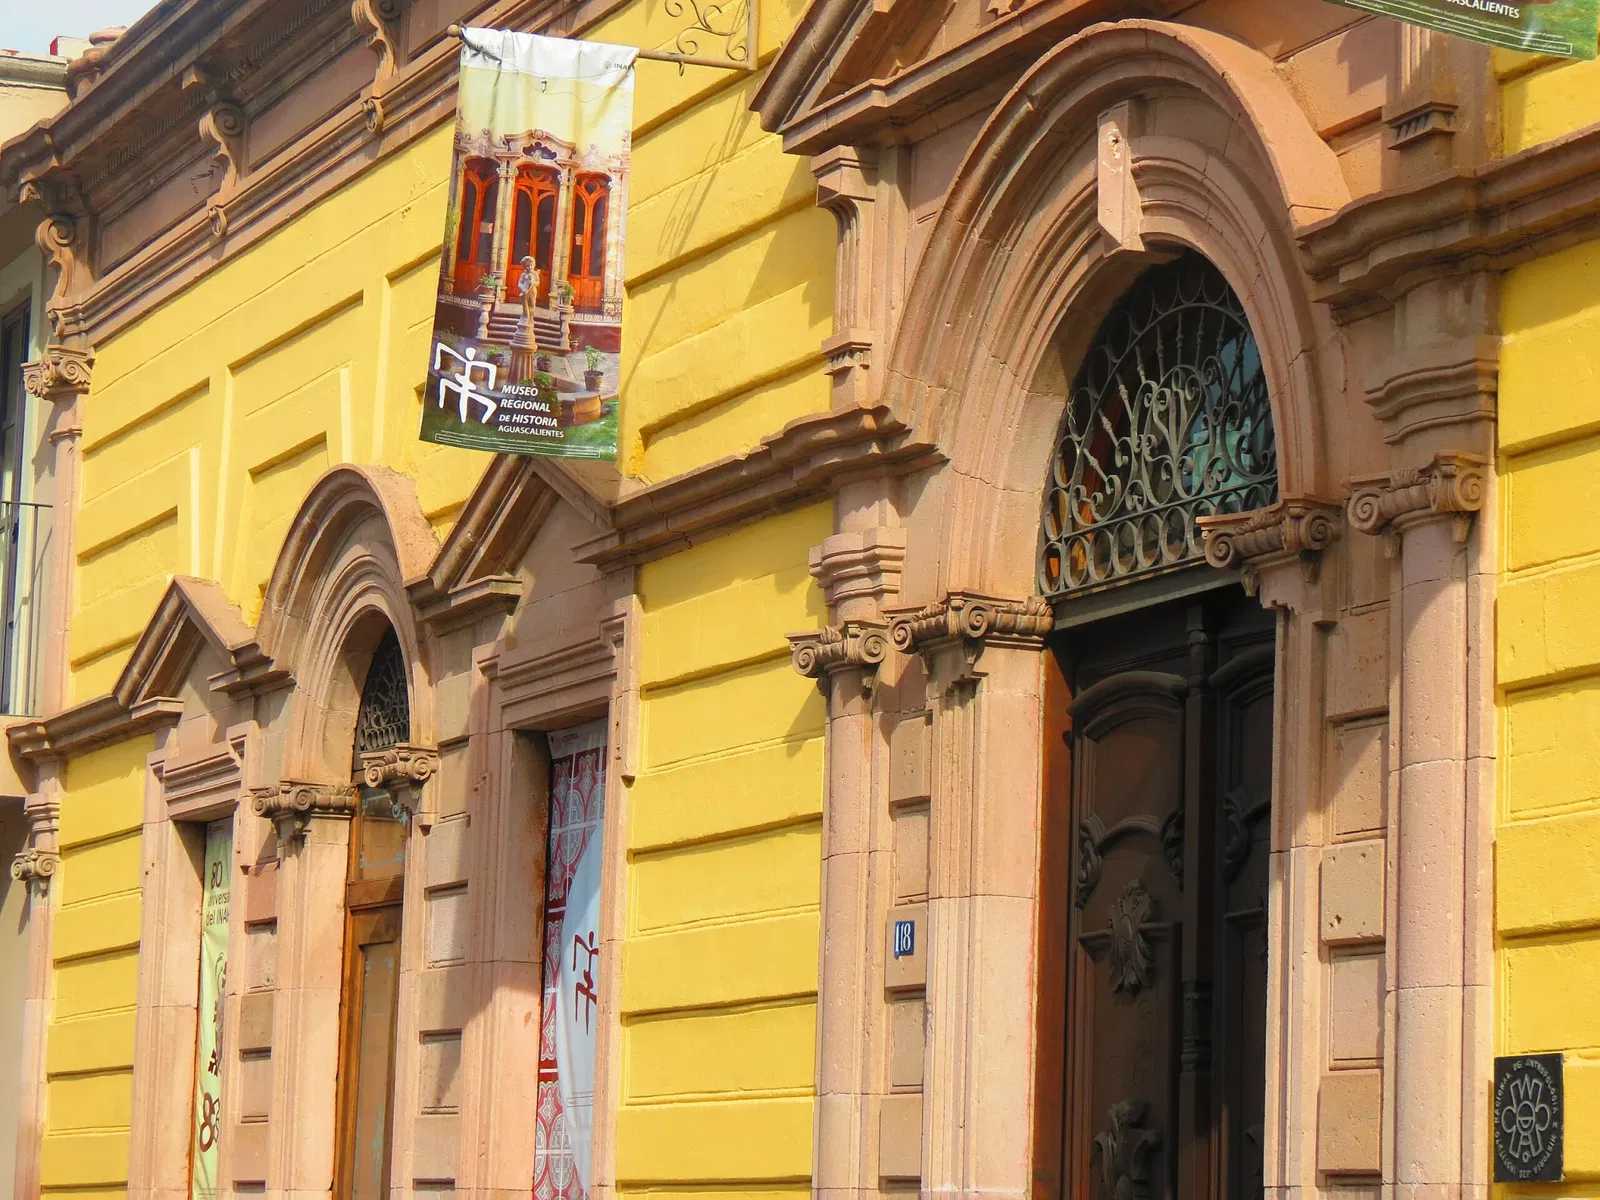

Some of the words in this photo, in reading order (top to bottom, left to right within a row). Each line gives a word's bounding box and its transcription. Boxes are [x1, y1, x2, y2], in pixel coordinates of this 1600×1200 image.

[501, 384, 539, 397] MUSEO
[500, 398, 551, 413] REGIONAL
[498, 414, 511, 422] DE
[511, 413, 558, 427] HISTORIA
[497, 425, 564, 438] AGUASCALIENTES
[210, 861, 222, 889] 80
[205, 910, 216, 926] del
[1533, 1134, 1557, 1174] HISTORIA
